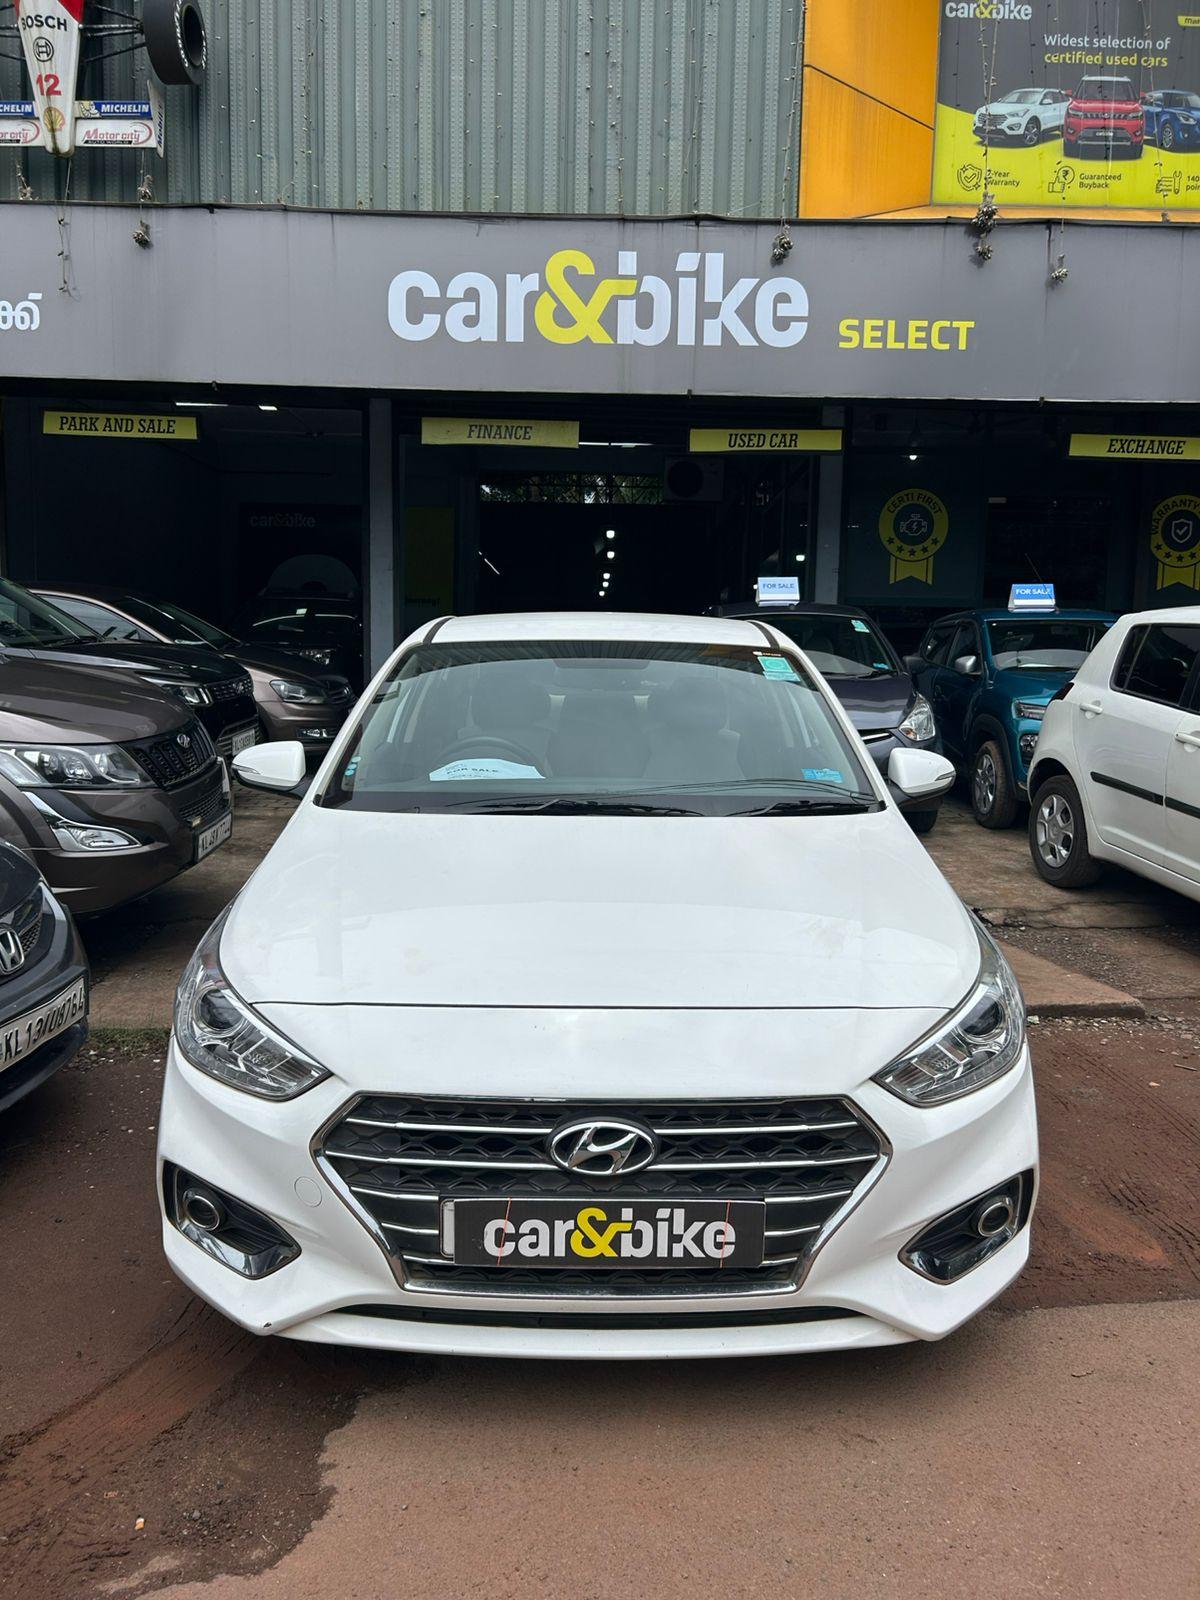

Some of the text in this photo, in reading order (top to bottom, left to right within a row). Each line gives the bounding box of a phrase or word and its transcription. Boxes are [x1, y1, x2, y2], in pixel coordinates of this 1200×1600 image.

[945, 0, 1033, 20] car&bike
[21, 14, 67, 31] BOSCH
[1044, 34, 1171, 50] Widest selection of
[1044, 52, 1169, 67] certified used cars
[36, 73, 62, 96] 12
[101, 103, 149, 113] MICHELIN
[83, 128, 140, 143] Motor city
[1078, 181, 1110, 190] Buyback
[1079, 172, 1122, 182] Guaranteed
[387, 248, 809, 348] car&bike
[838, 318, 975, 351] SELECT
[59, 415, 176, 434] PARK AND SALE
[467, 424, 533, 441] FINANCE
[728, 433, 799, 448] USED CAR
[1107, 438, 1186, 455] EXCHANGE
[483, 1206, 736, 1258] car&bike
